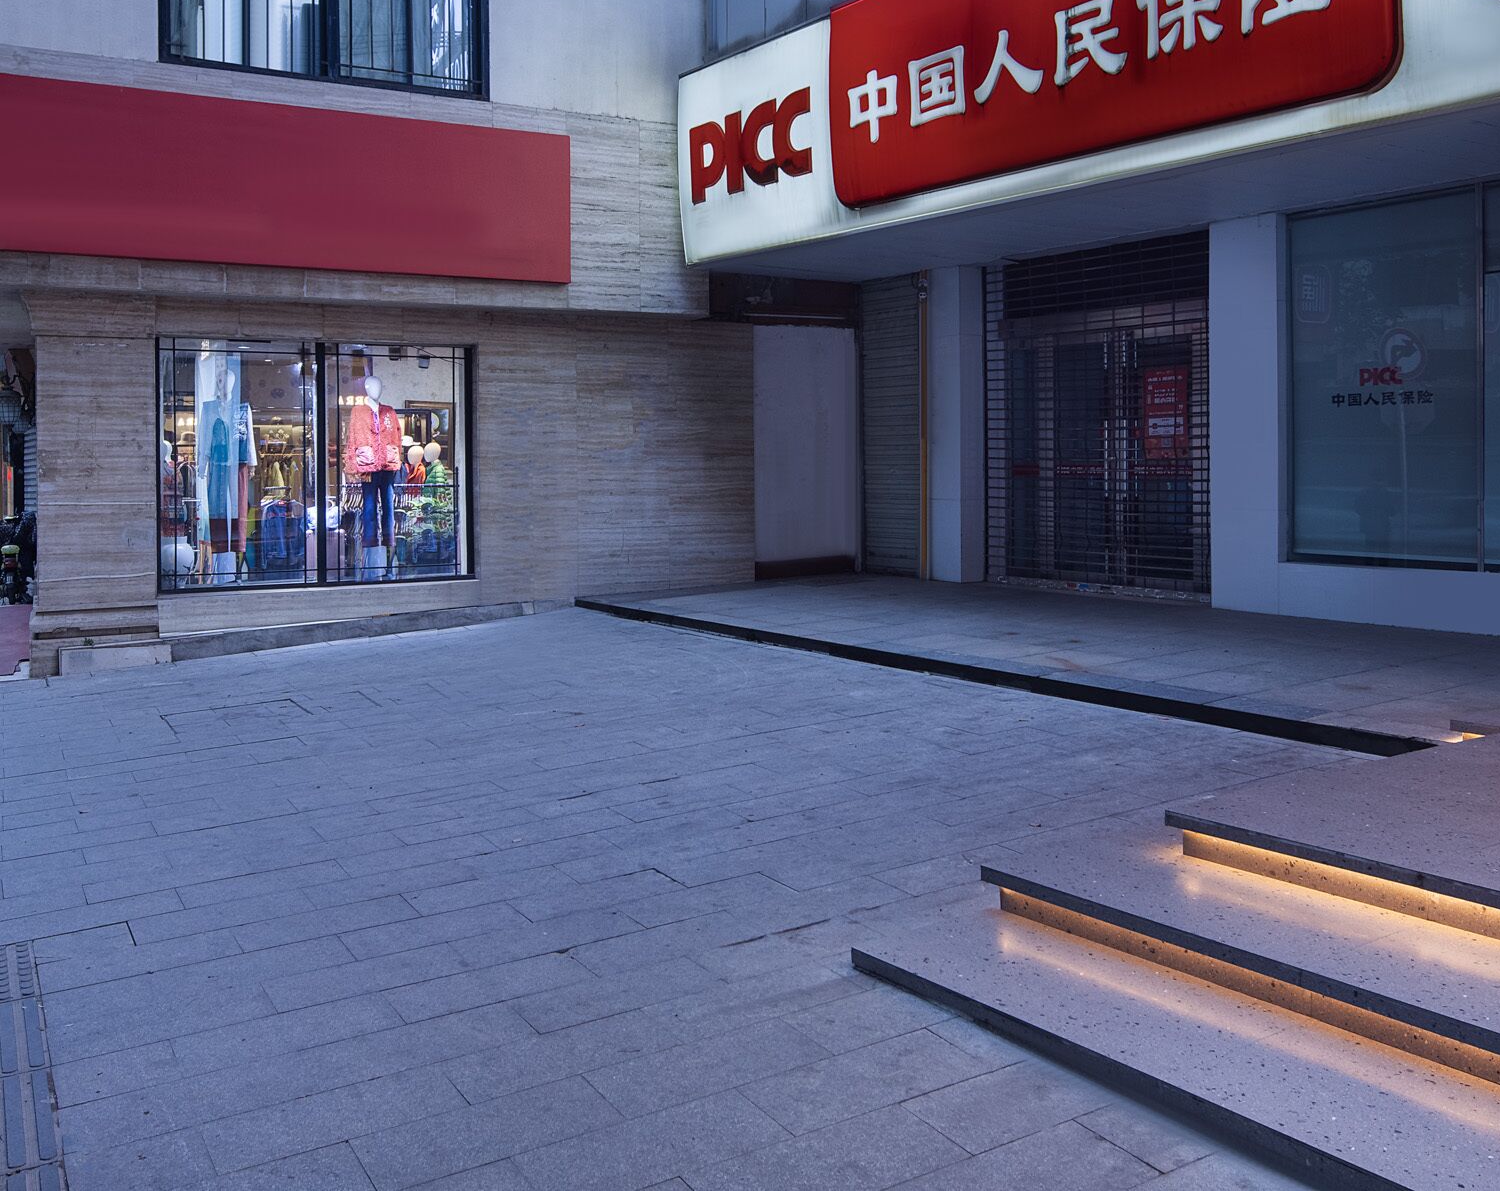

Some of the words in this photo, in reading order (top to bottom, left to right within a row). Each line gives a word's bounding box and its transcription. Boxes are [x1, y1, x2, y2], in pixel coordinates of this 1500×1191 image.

[688, 86, 813, 206] PICC
[1359, 366, 1403, 387] PICC
[1331, 389, 1434, 408] 中国人民保险
